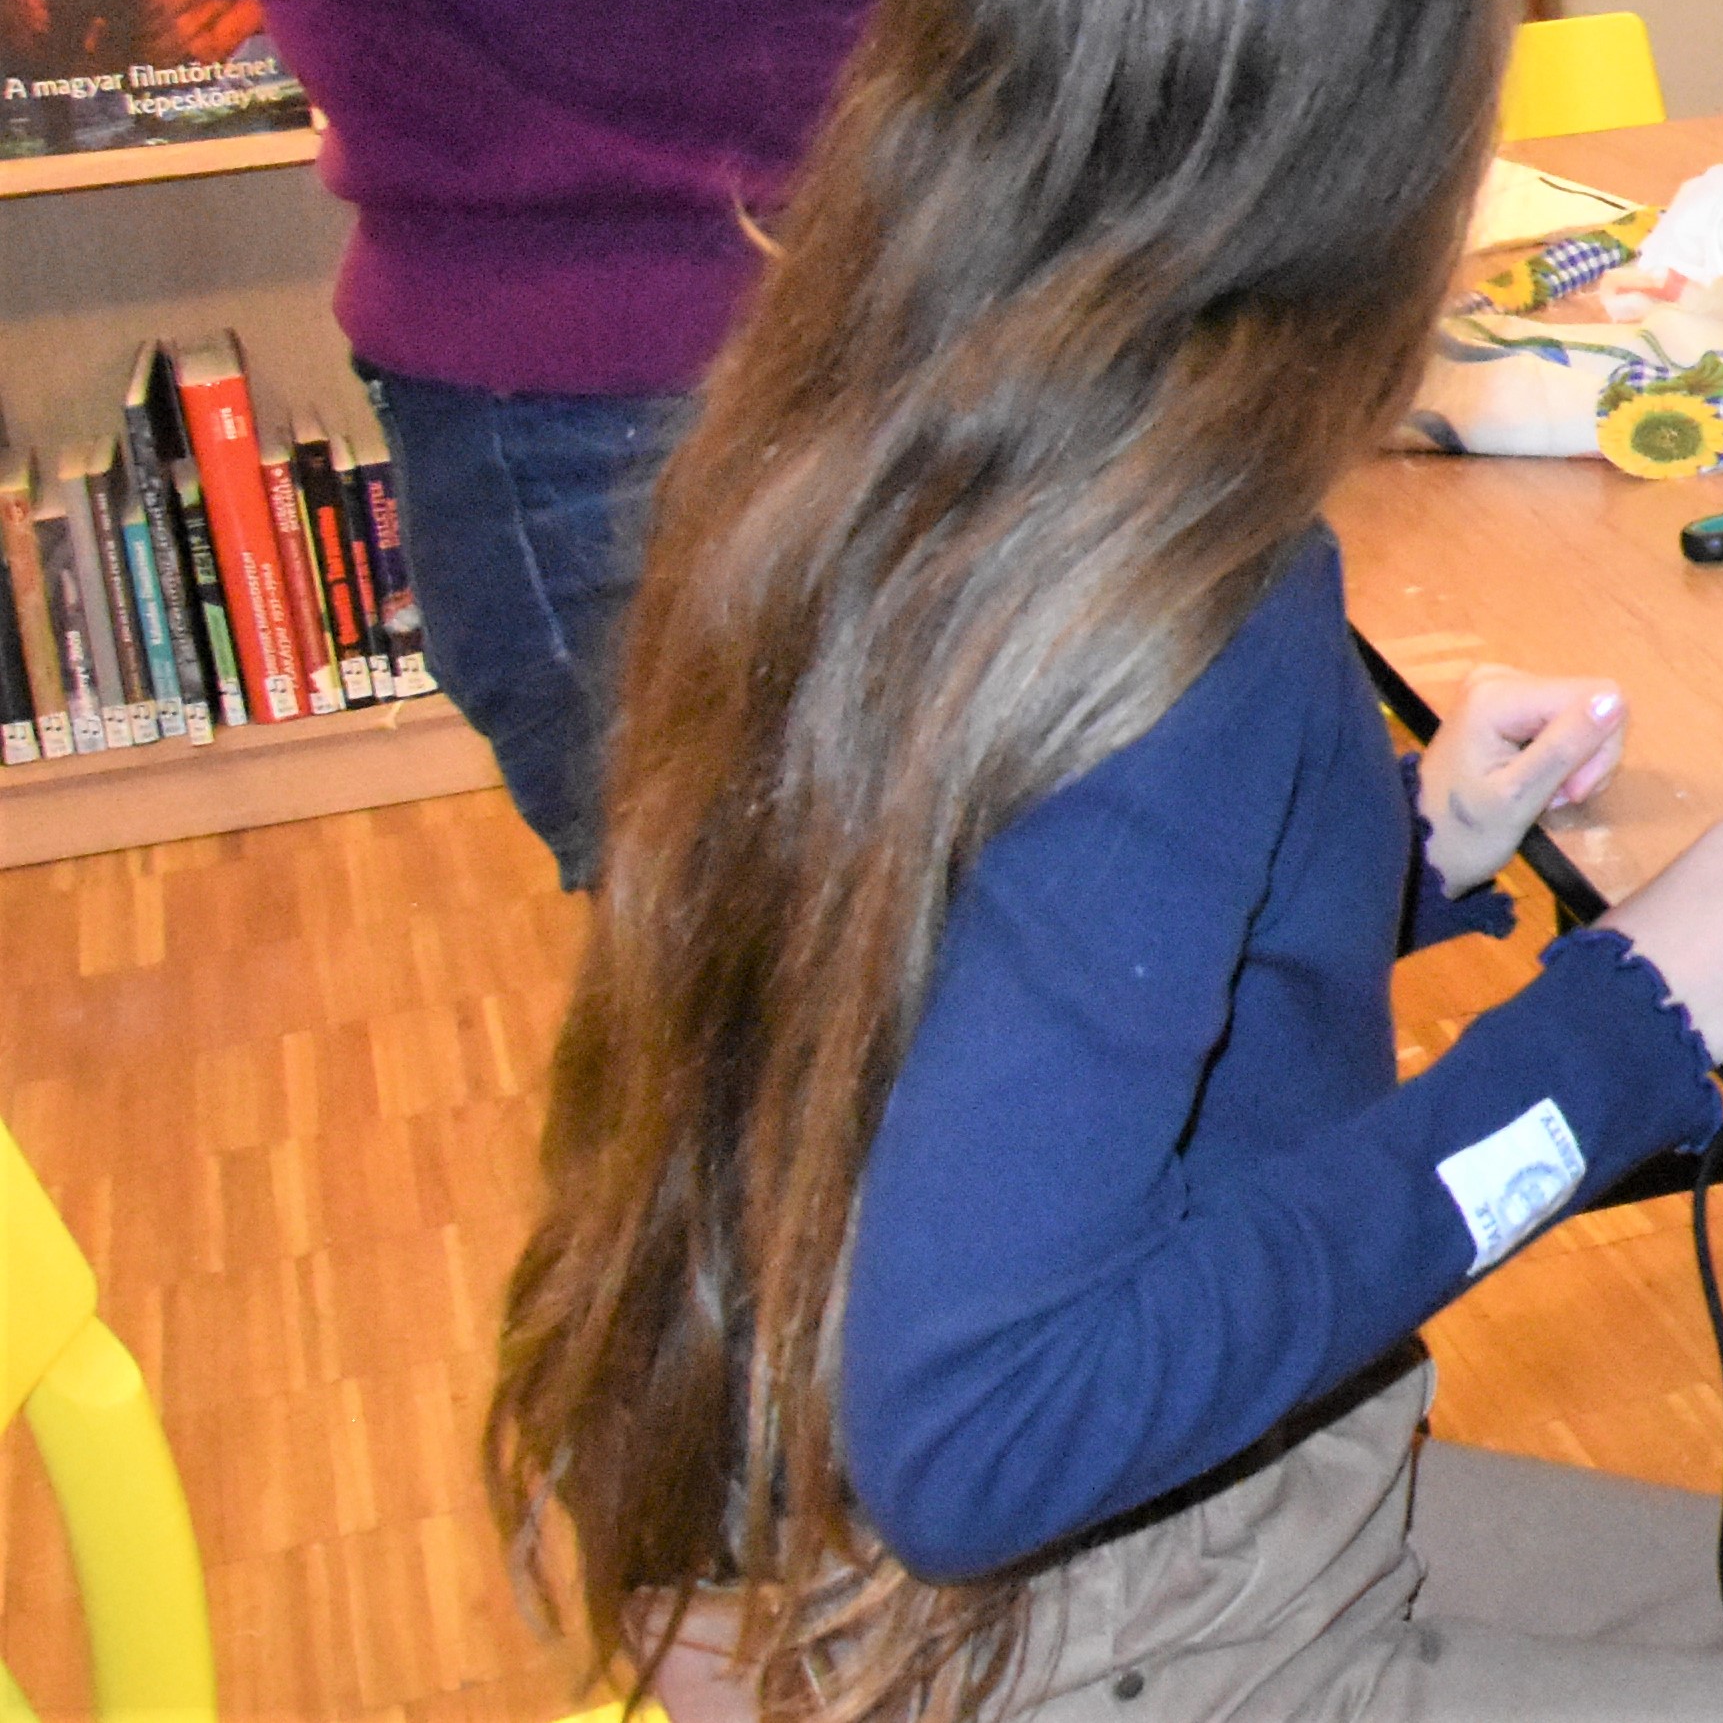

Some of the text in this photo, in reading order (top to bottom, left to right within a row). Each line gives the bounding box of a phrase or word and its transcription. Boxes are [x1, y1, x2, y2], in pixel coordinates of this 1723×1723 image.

[4, 56, 279, 105] A magyar filmtörténet
[127, 82, 284, 117] képeskönyve
